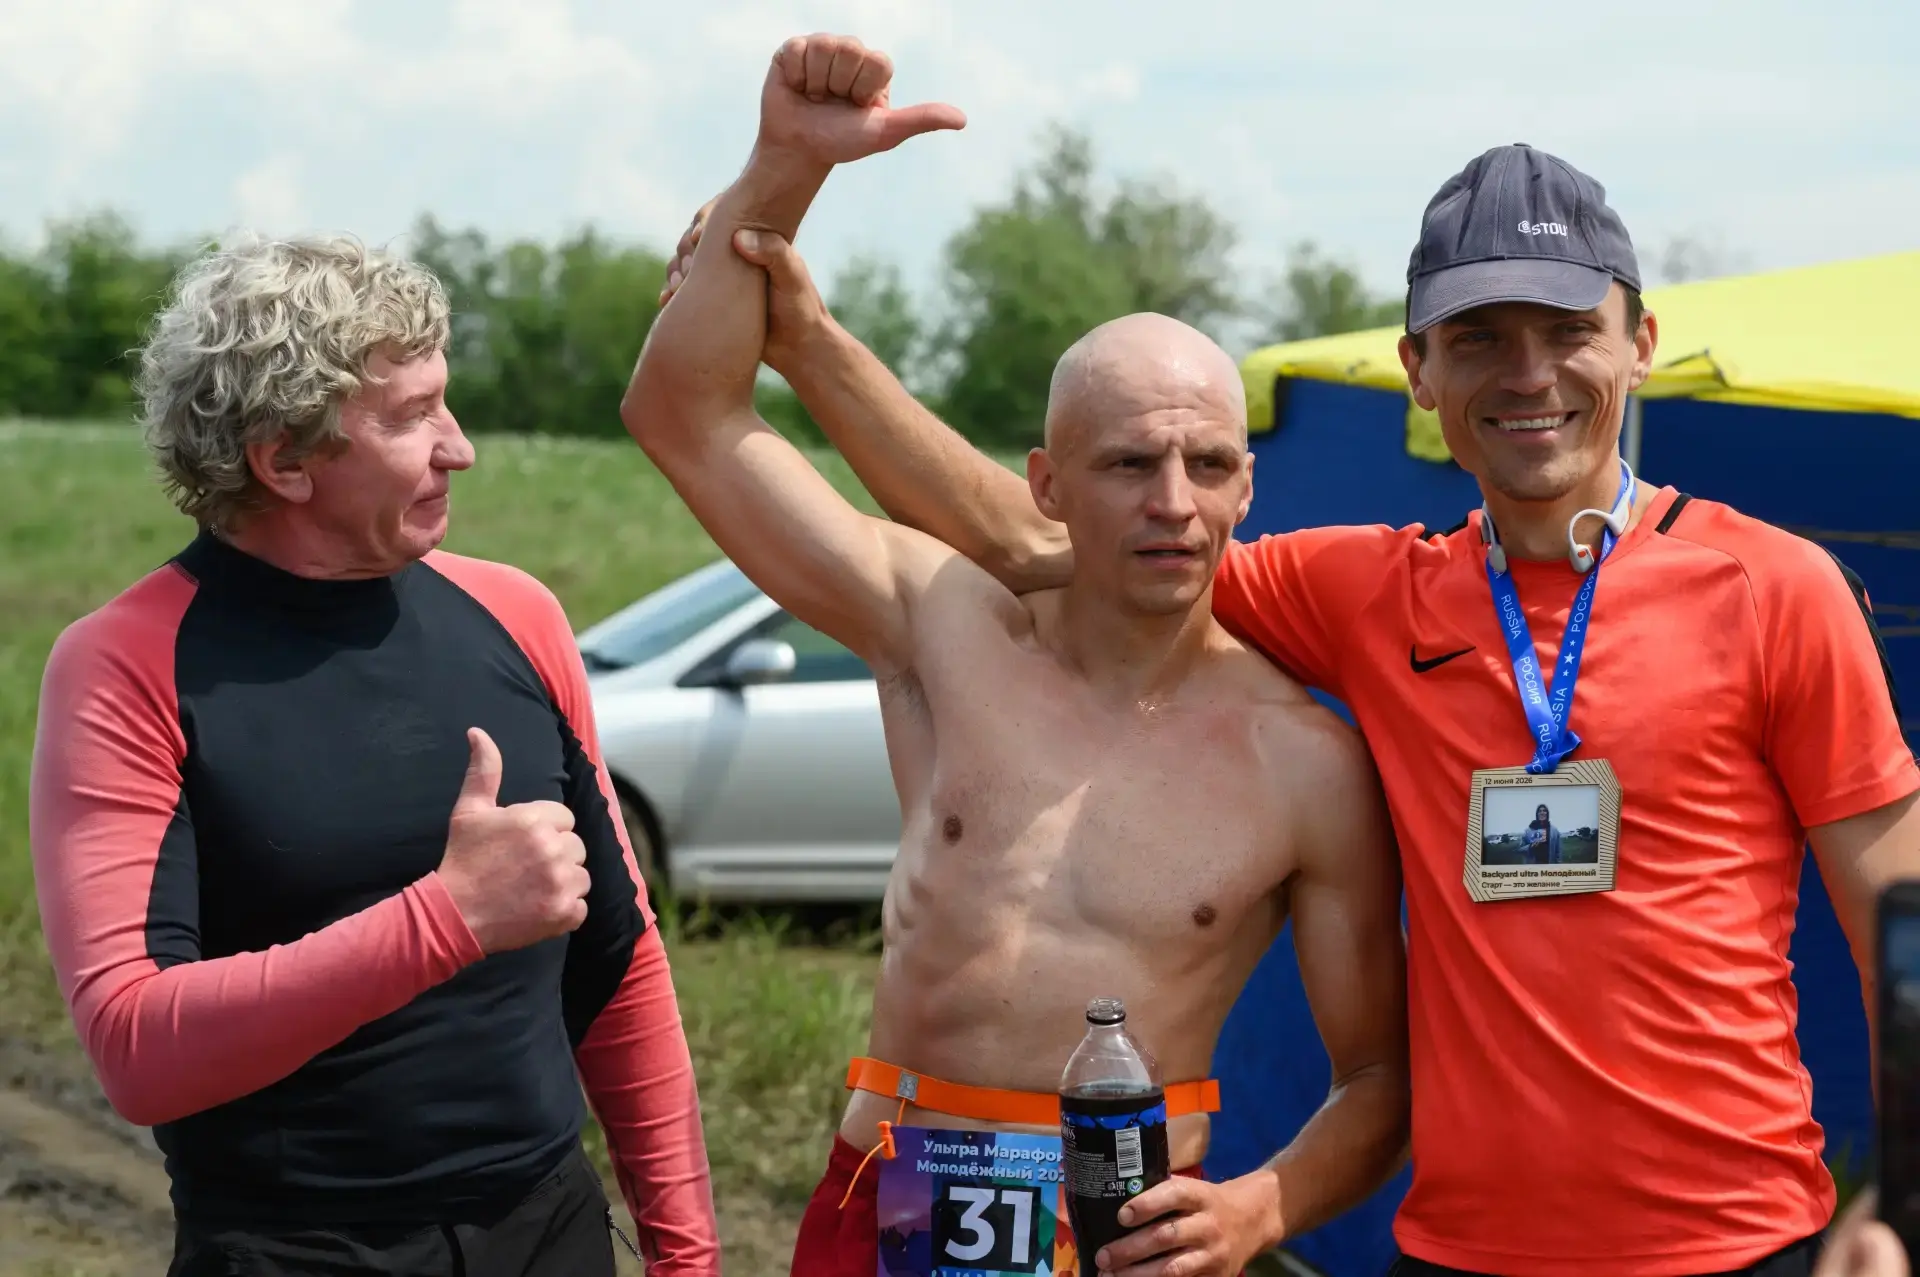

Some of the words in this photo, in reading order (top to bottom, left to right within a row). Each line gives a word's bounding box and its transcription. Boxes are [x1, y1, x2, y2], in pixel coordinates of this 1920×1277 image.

[1532, 222, 1568, 238] STOU
[1501, 594, 1522, 640] RUSSIA
[1571, 571, 1596, 632] РОССИЯ
[1520, 656, 1542, 705] РОССИЯ
[1552, 687, 1568, 731] SSIA
[1481, 870, 1518, 879] Backyard
[1520, 870, 1539, 878] ultra
[1540, 869, 1597, 878] Молодёжный
[1481, 881, 1503, 889] Старт
[1526, 880, 1561, 888] желание
[923, 1139, 979, 1159] Ультра
[916, 1159, 1033, 1180] Молодёжный
[1037, 1167, 1065, 1183] 202
[944, 1186, 1034, 1264] 31
